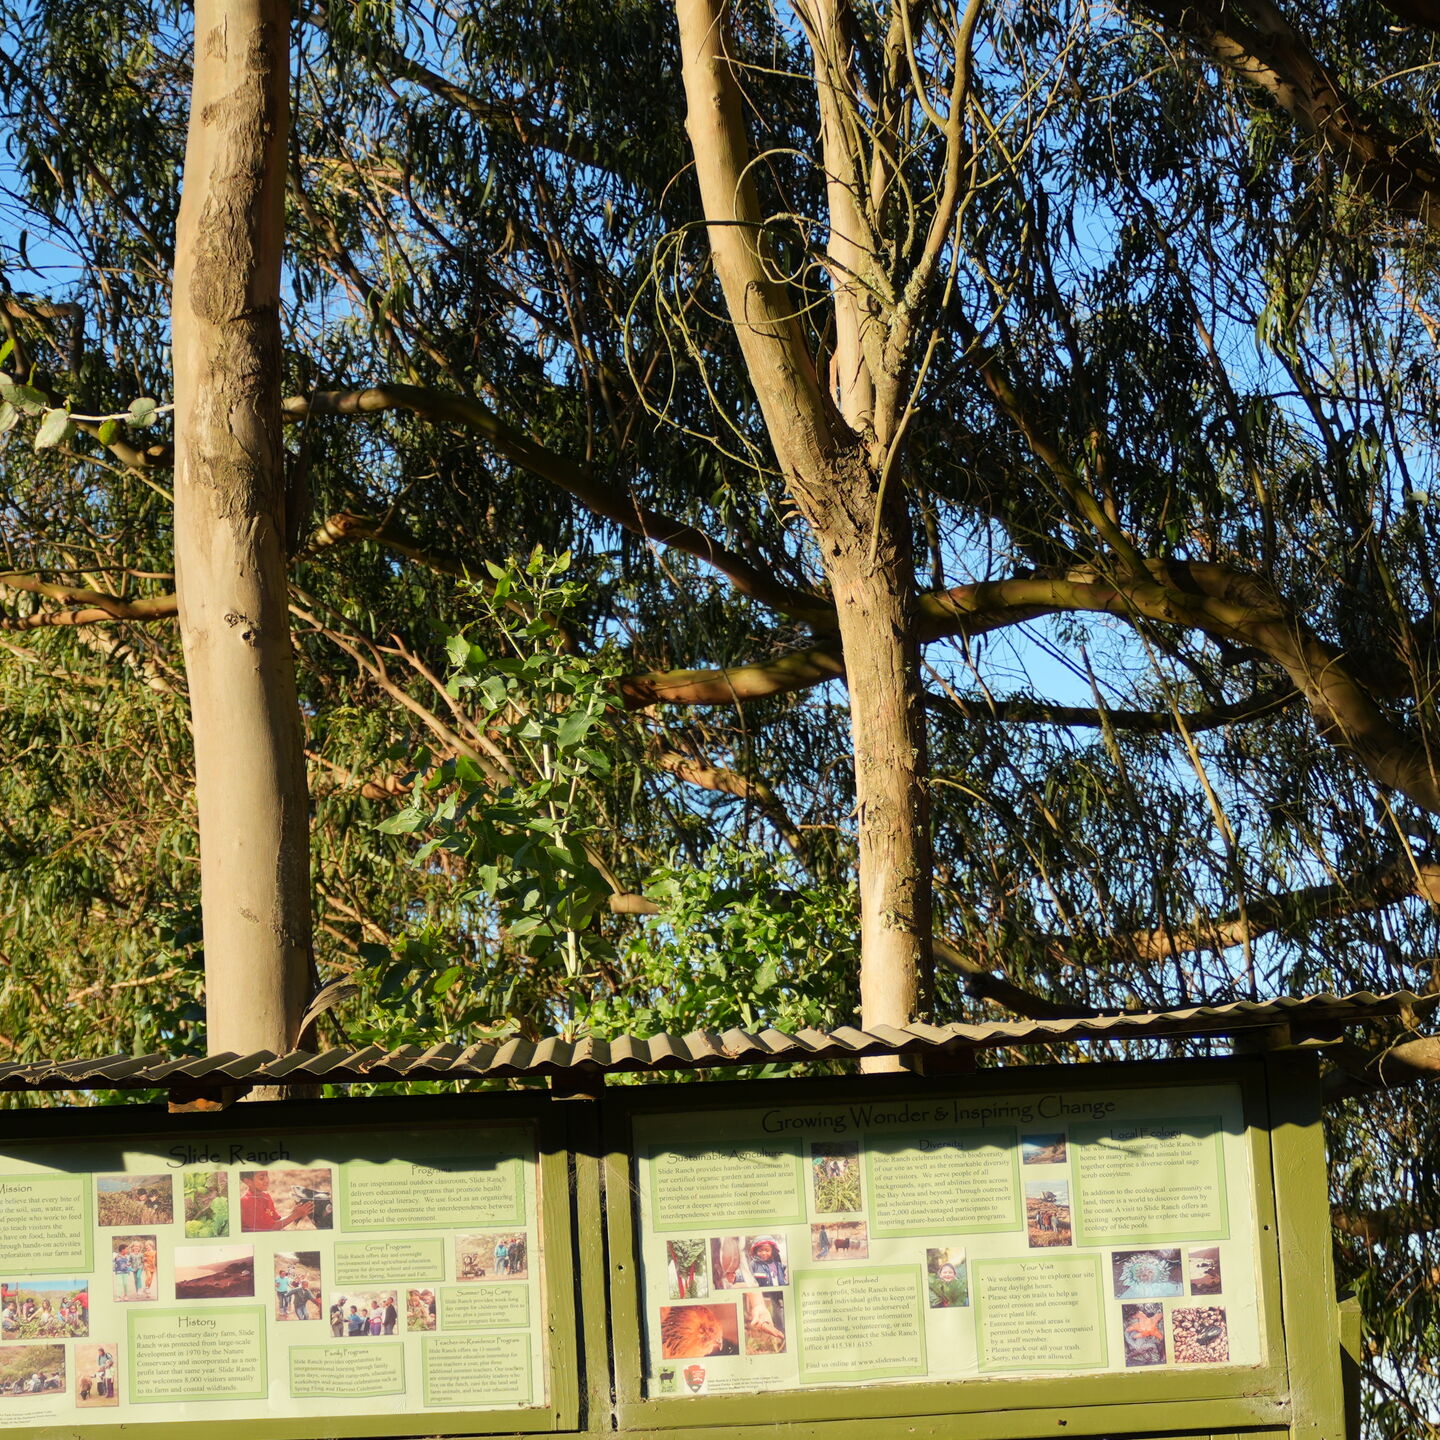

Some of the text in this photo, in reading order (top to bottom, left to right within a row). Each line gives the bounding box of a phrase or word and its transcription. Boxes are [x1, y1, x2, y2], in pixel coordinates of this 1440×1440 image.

[761, 1096, 1115, 1134] Growing Wonder & Inspiring Change
[1111, 1126, 1182, 1140] Local Ecology
[919, 1140, 964, 1150] Diversity
[167, 1141, 290, 1168] Slide Ranch
[667, 1144, 784, 1164] Sustainable Agriculture
[412, 1165, 452, 1177] Programs
[911, 1207, 953, 1215] disadvantaged
[661, 1212, 710, 1220] interdependence
[1085, 1224, 1108, 1232] ecology
[385, 1243, 411, 1251] Programs
[1020, 1264, 1038, 1272] Your
[837, 1276, 879, 1286] Get Involved
[1027, 1275, 1038, 1284] you
[456, 1288, 512, 1297] Summer Day Camp
[178, 1315, 216, 1329] History
[172, 1340, 200, 1348] protected
[203, 1348, 210, 1356] by
